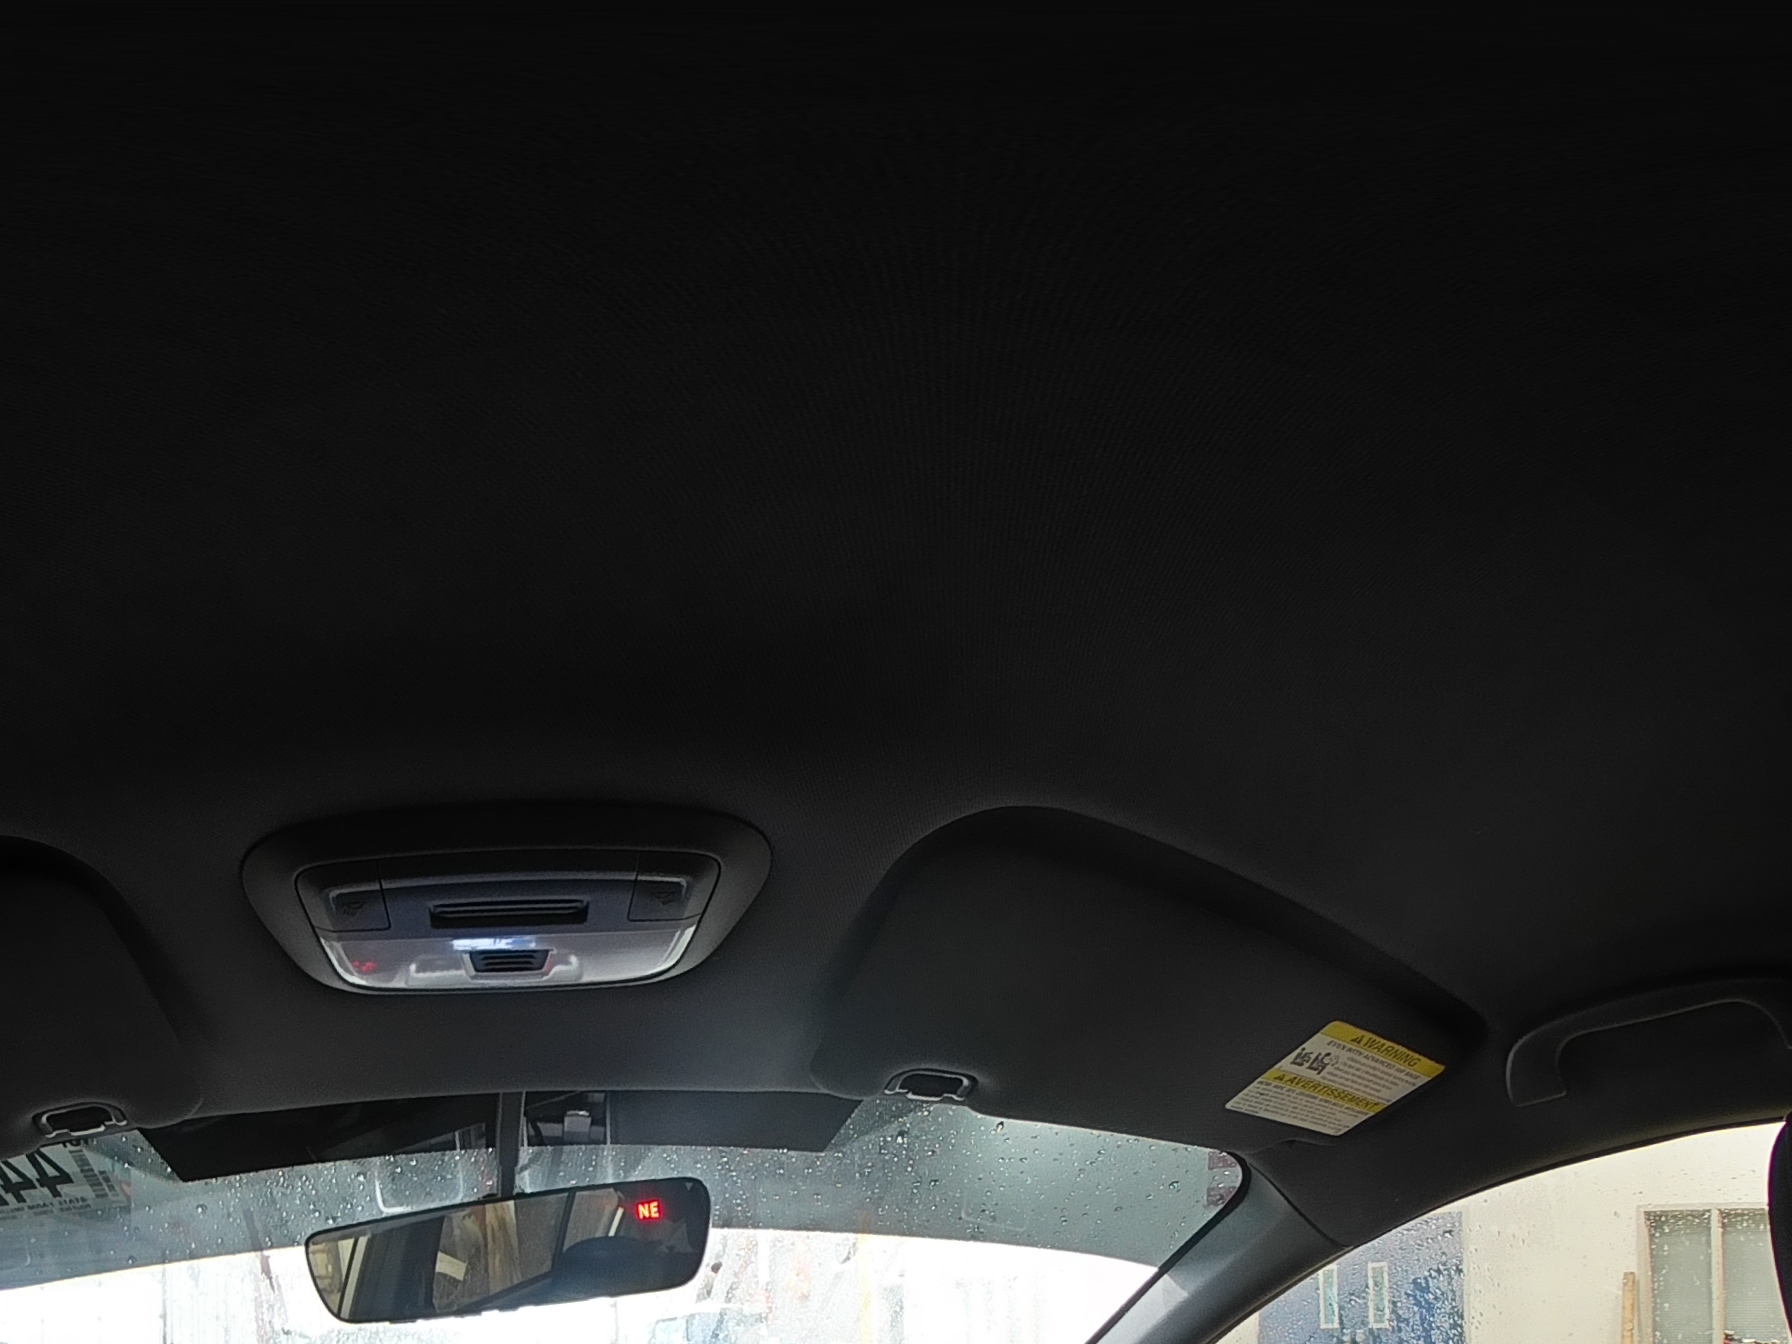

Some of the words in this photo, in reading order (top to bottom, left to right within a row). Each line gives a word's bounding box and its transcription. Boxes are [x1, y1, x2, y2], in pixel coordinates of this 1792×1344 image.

[1363, 1037, 1421, 1067] WARNING
[1287, 1076, 1381, 1109] AVERTISSEMENT
[638, 1201, 660, 1220] NE
